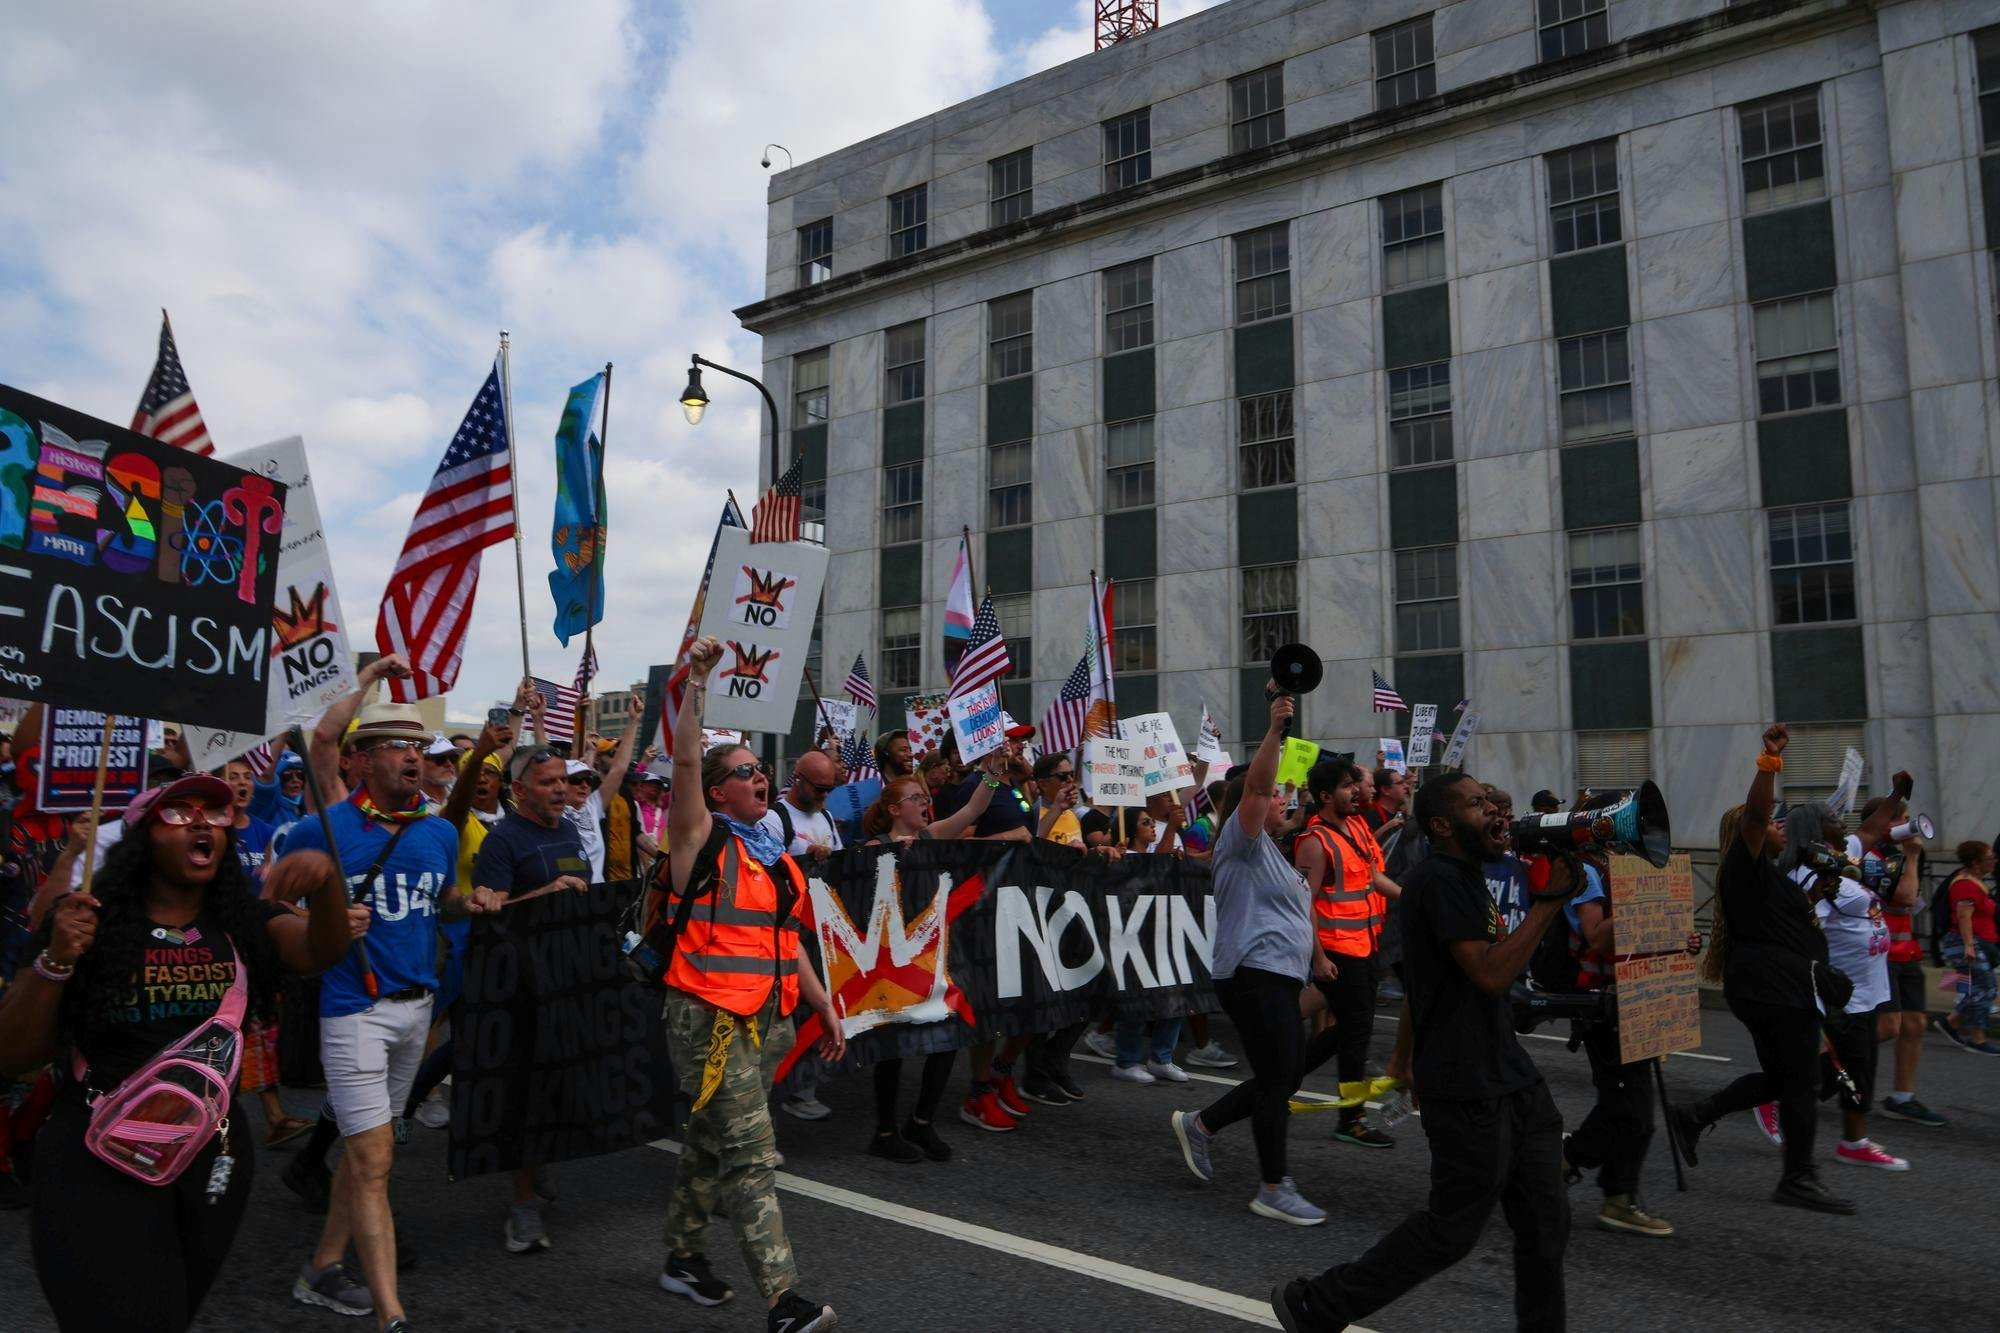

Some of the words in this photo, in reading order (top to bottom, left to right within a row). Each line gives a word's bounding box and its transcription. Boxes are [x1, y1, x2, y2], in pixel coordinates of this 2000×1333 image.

[43, 535, 86, 556] MATH
[744, 603, 777, 626] NO
[281, 635, 335, 685] NO
[288, 663, 340, 700] KINGS
[728, 675, 762, 699] NO
[54, 708, 142, 727] DEMOCACY
[1135, 720, 1149, 734] WE
[110, 729, 141, 744] FEAR
[1104, 745, 1116, 759] THE
[1115, 747, 1131, 760] MOST
[995, 885, 1105, 998] NO
[144, 948, 213, 964] KINGS
